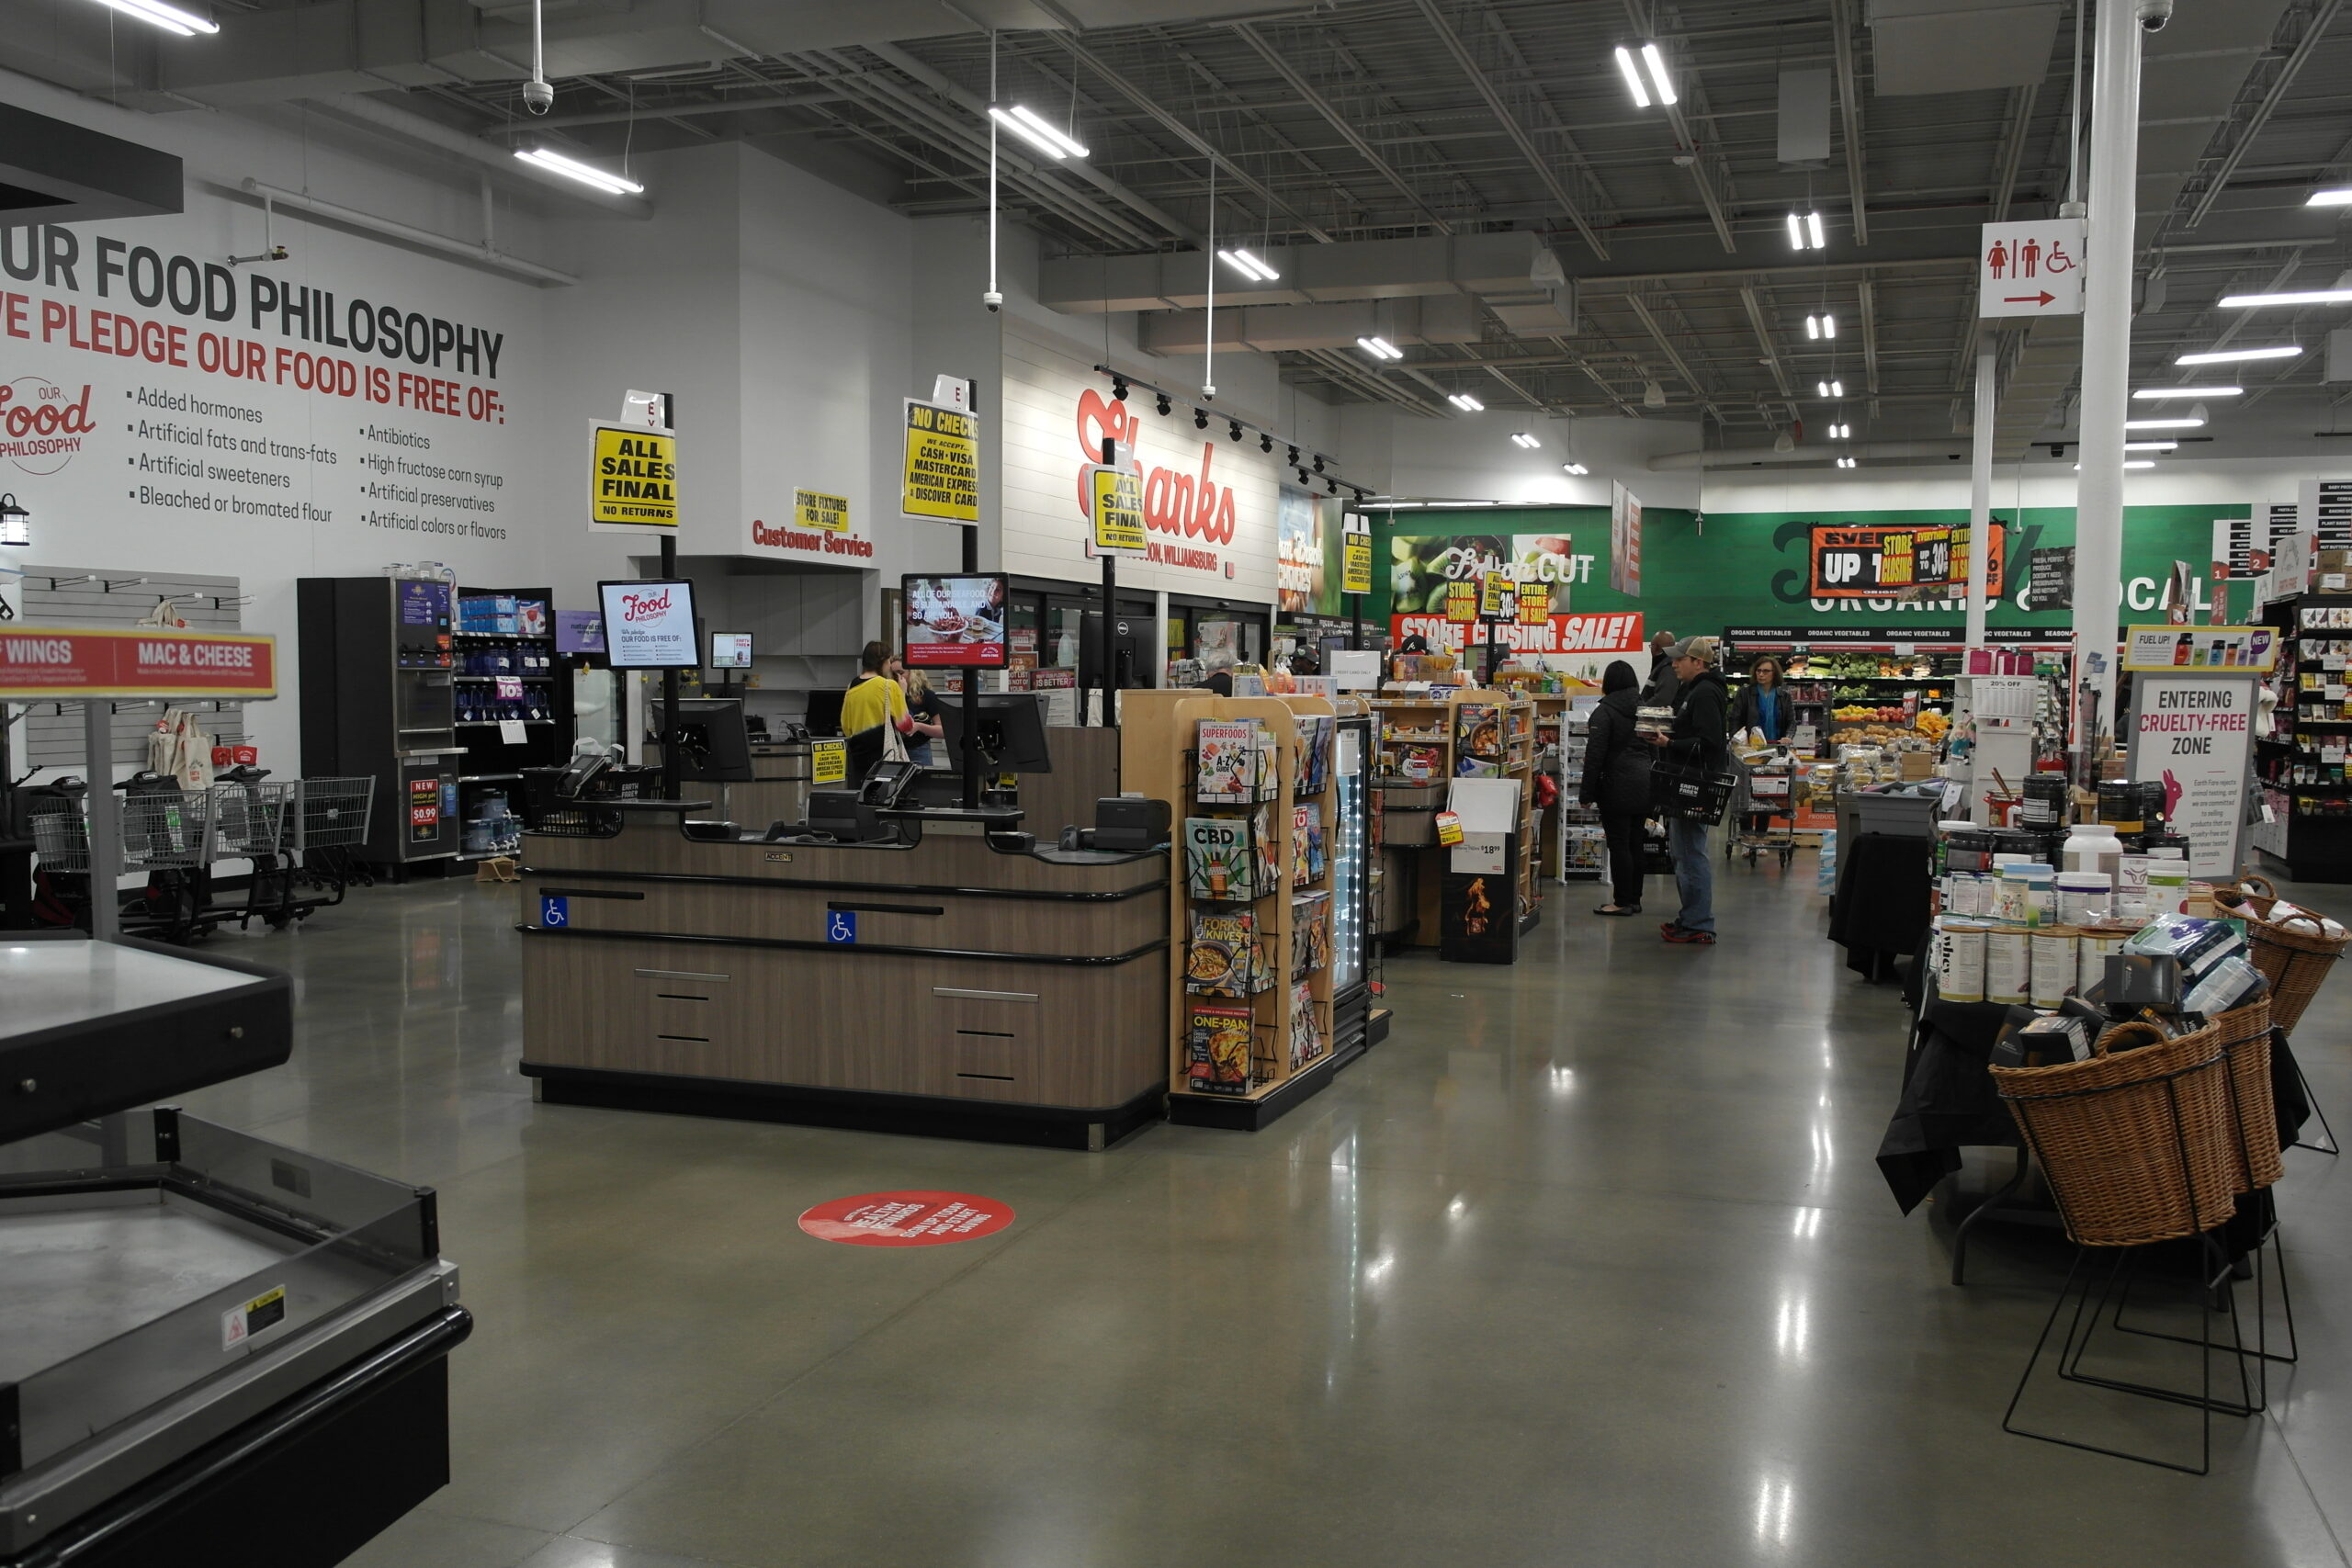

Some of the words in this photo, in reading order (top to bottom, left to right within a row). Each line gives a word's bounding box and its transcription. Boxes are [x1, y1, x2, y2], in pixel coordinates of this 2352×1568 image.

[97, 235, 237, 322] FOOD
[251, 274, 503, 378] PHILOSOPHY
[0, 291, 29, 339] E
[42, 300, 187, 368] PLEDGE
[197, 332, 266, 382] OUR
[276, 347, 357, 398] FOOD
[365, 365, 391, 403] IS
[398, 373, 460, 417] FREE
[468, 386, 504, 424] OF:
[39, 387, 61, 400] OUR
[137, 387, 186, 412] Added
[191, 394, 263, 423] hormones
[913, 407, 932, 429] NO
[139, 420, 202, 448] Artificial
[208, 428, 236, 451] fats
[240, 433, 266, 455] and
[270, 439, 337, 465] trans-fats
[368, 425, 430, 449] Antibiotics
[0, 437, 81, 457] PHILOSOPHY
[619, 439, 662, 459] ALL
[920, 446, 944, 460] CASH
[950, 452, 973, 465] VISA
[139, 453, 203, 478] Artificial
[208, 464, 290, 489] sweeteners
[368, 453, 393, 476] High
[397, 458, 446, 481] fructose
[448, 468, 472, 483] corn
[475, 471, 503, 489] syrup
[601, 457, 675, 480] SALES
[915, 459, 976, 478] MASTERCARD
[602, 479, 674, 501] FINAL
[909, 472, 944, 488] AMERICAN
[947, 478, 978, 493] EXPRESS
[1115, 478, 1136, 494] ALL
[140, 486, 210, 510] Bleached
[214, 497, 228, 510] or
[233, 495, 298, 519] bromated
[303, 501, 332, 523] flour
[369, 482, 418, 504] Artificial
[421, 489, 494, 514] preservatives
[797, 492, 816, 506] STORE
[819, 496, 847, 512] FIXTURES
[916, 487, 951, 503] DISCOVER
[955, 493, 977, 506] CARD
[1103, 494, 1142, 512] SALES
[603, 506, 616, 515] NO
[622, 506, 673, 518] RETURNS
[806, 509, 819, 523] FOR
[821, 511, 839, 526] SALE!
[1105, 512, 1142, 528] FINAL
[369, 511, 418, 532] Artificial
[421, 516, 454, 536] colors
[458, 523, 468, 536] or
[471, 520, 506, 539] flavors
[753, 520, 821, 551] Customer
[824, 530, 873, 557] Service
[1106, 532, 1116, 541] NO
[1118, 534, 1143, 543] RETURNS
[1348, 534, 1358, 544] NO
[1884, 534, 1912, 556] STORE
[1917, 530, 1948, 542] EVERYTHING
[1164, 544, 1217, 572] WILLIAMSBURG
[1920, 550, 1929, 560] UP
[2253, 559, 2260, 568] 2
[1538, 553, 1594, 584] CUT
[1825, 553, 1861, 583] UP
[1882, 556, 1912, 582] CLOSING
[1920, 560, 1929, 570] TO
[1950, 560, 1959, 579] ON
[2214, 571, 2221, 579] 1
[1449, 582, 1475, 598] STORE
[1521, 584, 1548, 595] ENTIRE
[623, 589, 672, 621] Food
[1448, 598, 1476, 621] CLOSING
[1522, 596, 1546, 607] STORE
[636, 611, 666, 622] PHILOSOPHY
[1521, 607, 1529, 622] ON
[1530, 607, 1548, 623] SALE!
[1401, 617, 1464, 650] STORE
[1562, 615, 1636, 651] SALE!
[2139, 635, 2155, 644] FUEL
[2158, 636, 2170, 644] UP!
[2252, 634, 2270, 646] NEW
[6, 639, 73, 664] WINGS
[138, 642, 176, 666] MAC
[179, 644, 191, 666] &
[194, 645, 253, 668] CHEESE
[1044, 678, 1069, 686] BETTER
[2158, 690, 2232, 710] ENTERING
[2140, 713, 2247, 732] CRUELTY-FREE
[1202, 729, 1246, 738] SUPERFOODS
[2171, 737, 2211, 755] ZONE
[1217, 756, 1230, 766] A-Z
[415, 781, 434, 791] NEW
[622, 783, 639, 791] EARTH
[413, 808, 436, 819] $0.99
[1194, 828, 1234, 844] CBD
[1204, 919, 1242, 932] FORKS
[1206, 930, 1241, 941] KNIVES
[1194, 1016, 1247, 1029] ONE-PAN
[848, 1202, 906, 1228] HEALTHY
[869, 1204, 925, 1230] REWARDS
[899, 1224, 931, 1237] SIGN
[932, 1202, 968, 1217] TODAY
[927, 1224, 954, 1235] AND
[944, 1208, 979, 1224] START
[953, 1214, 992, 1232] SAVING
